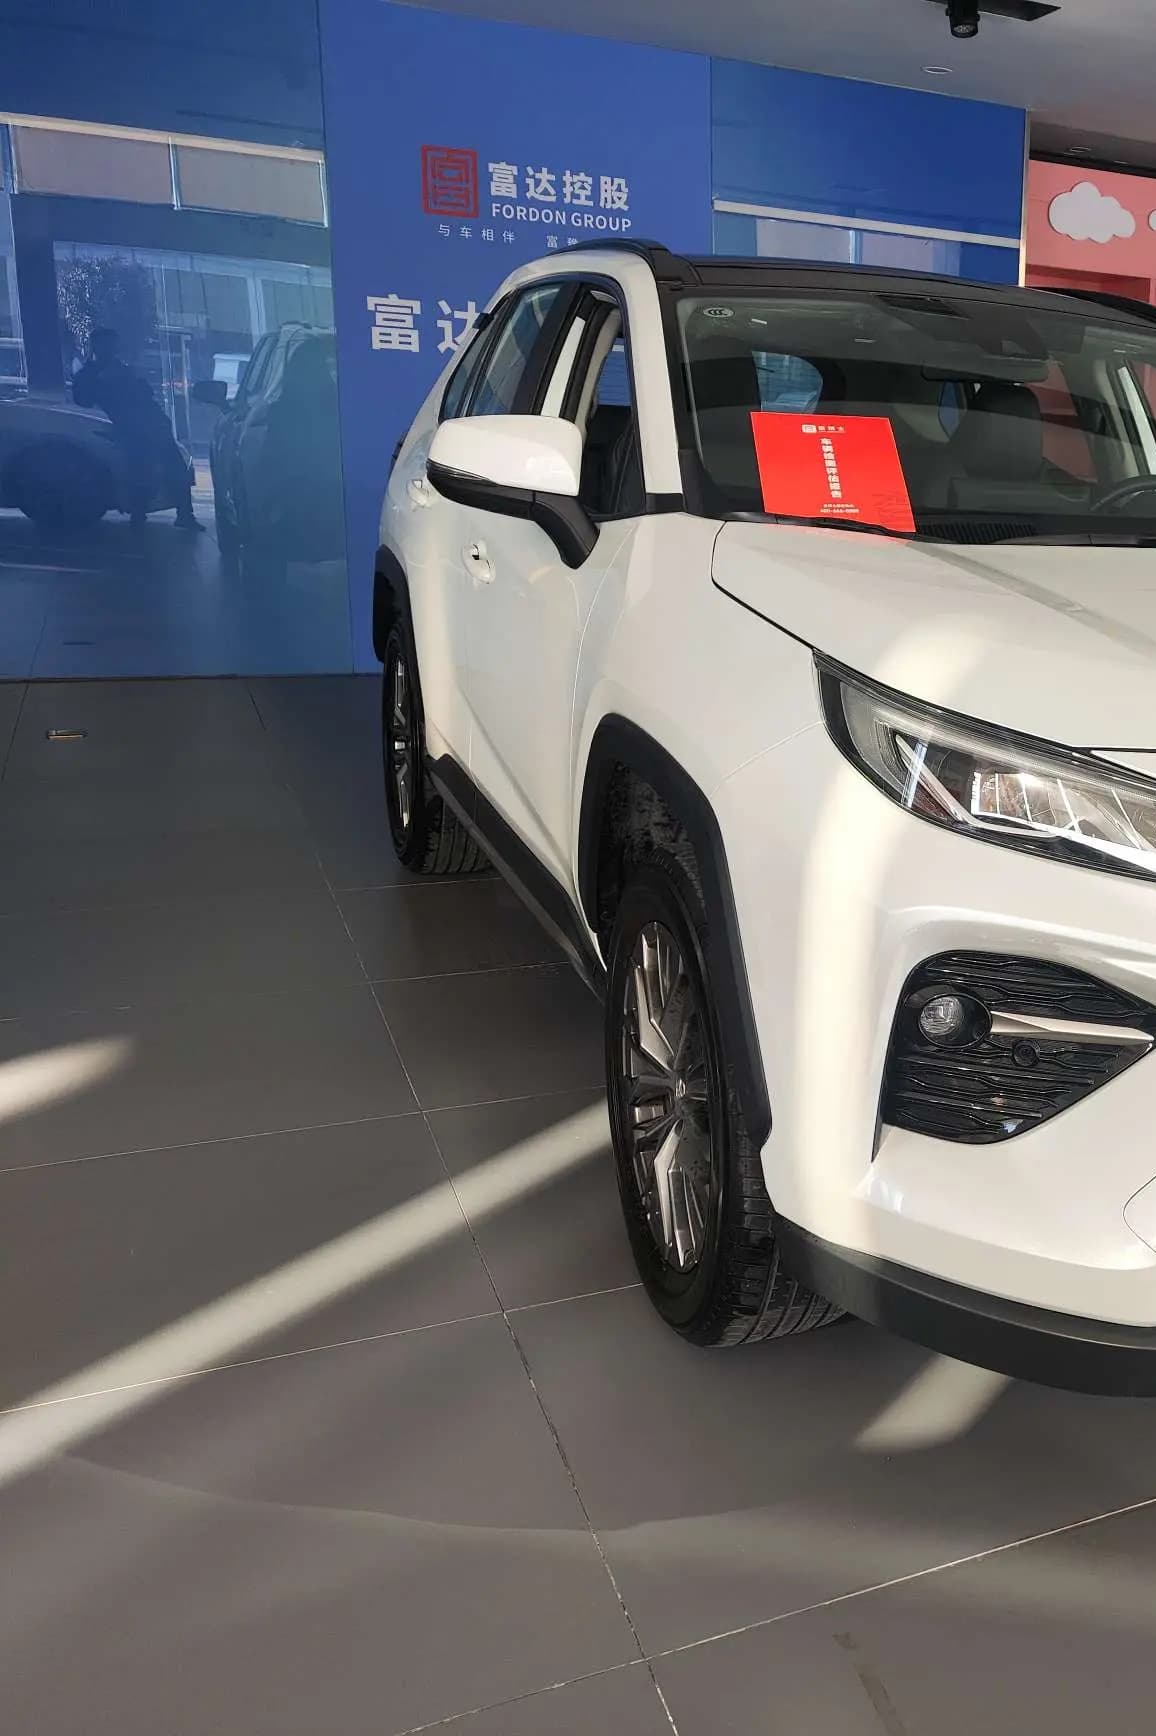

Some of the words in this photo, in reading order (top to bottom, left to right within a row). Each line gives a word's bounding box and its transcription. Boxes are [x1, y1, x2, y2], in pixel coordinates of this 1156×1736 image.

[488, 162, 630, 211] 富达控股
[492, 203, 566, 225] FORDON
[571, 212, 632, 231] GROUP
[438, 223, 515, 244] 与车相伴
